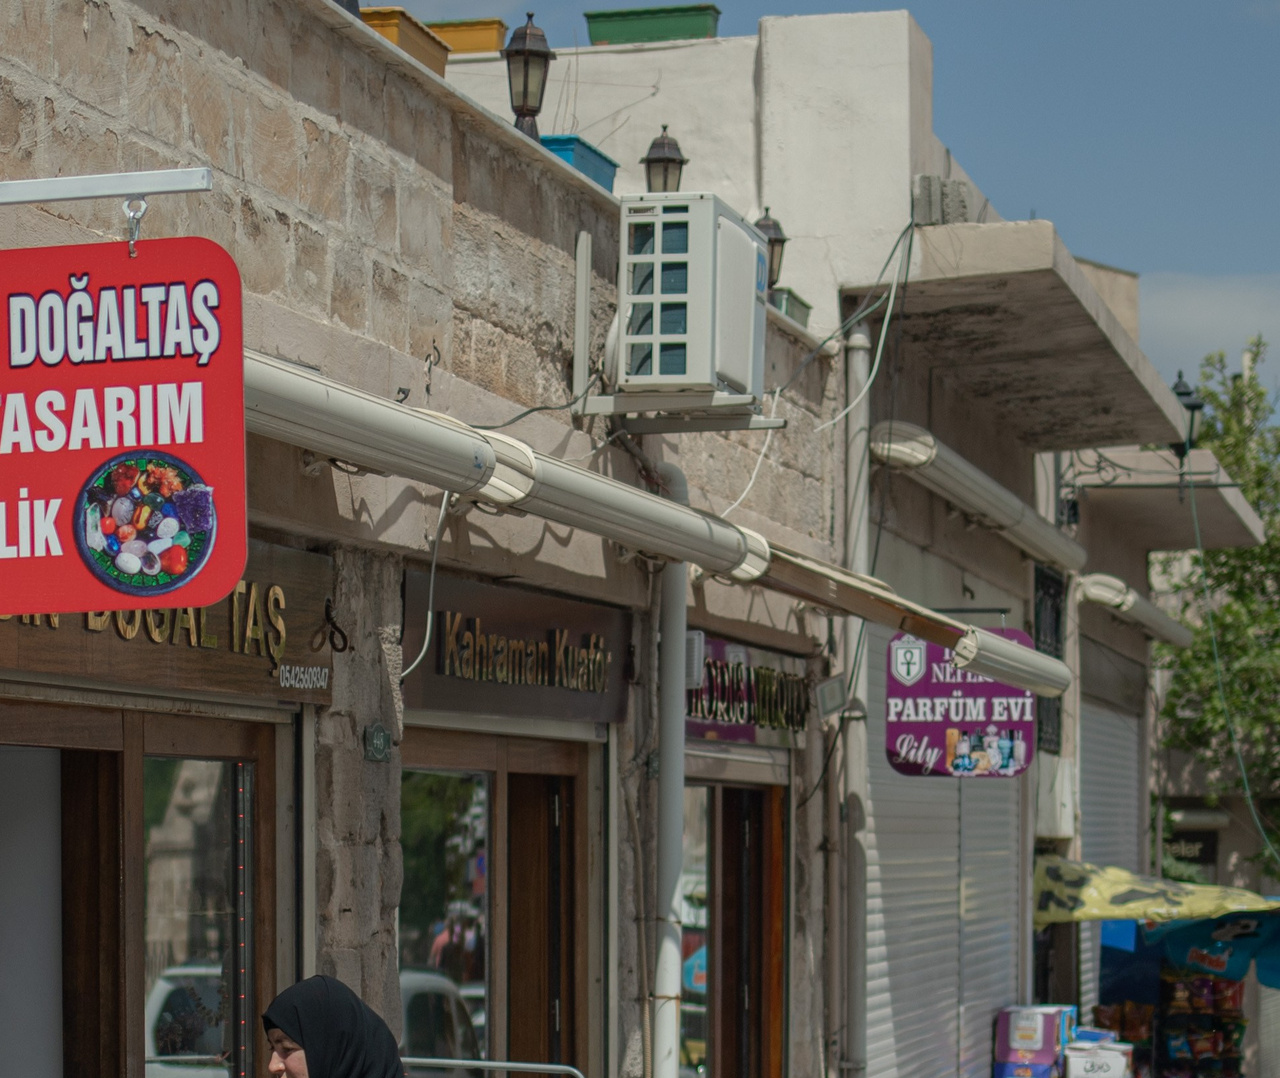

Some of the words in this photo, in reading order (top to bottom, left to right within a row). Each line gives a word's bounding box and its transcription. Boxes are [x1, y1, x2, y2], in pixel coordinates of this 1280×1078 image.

[8, 273, 221, 367] DOĞALTAŞ
[442, 610, 549, 685] Kahraman
[279, 664, 329, 689] 05425609347
[887, 690, 986, 722] PARFÜM
[991, 689, 1034, 722] EVİ
[893, 733, 943, 775] Lily
